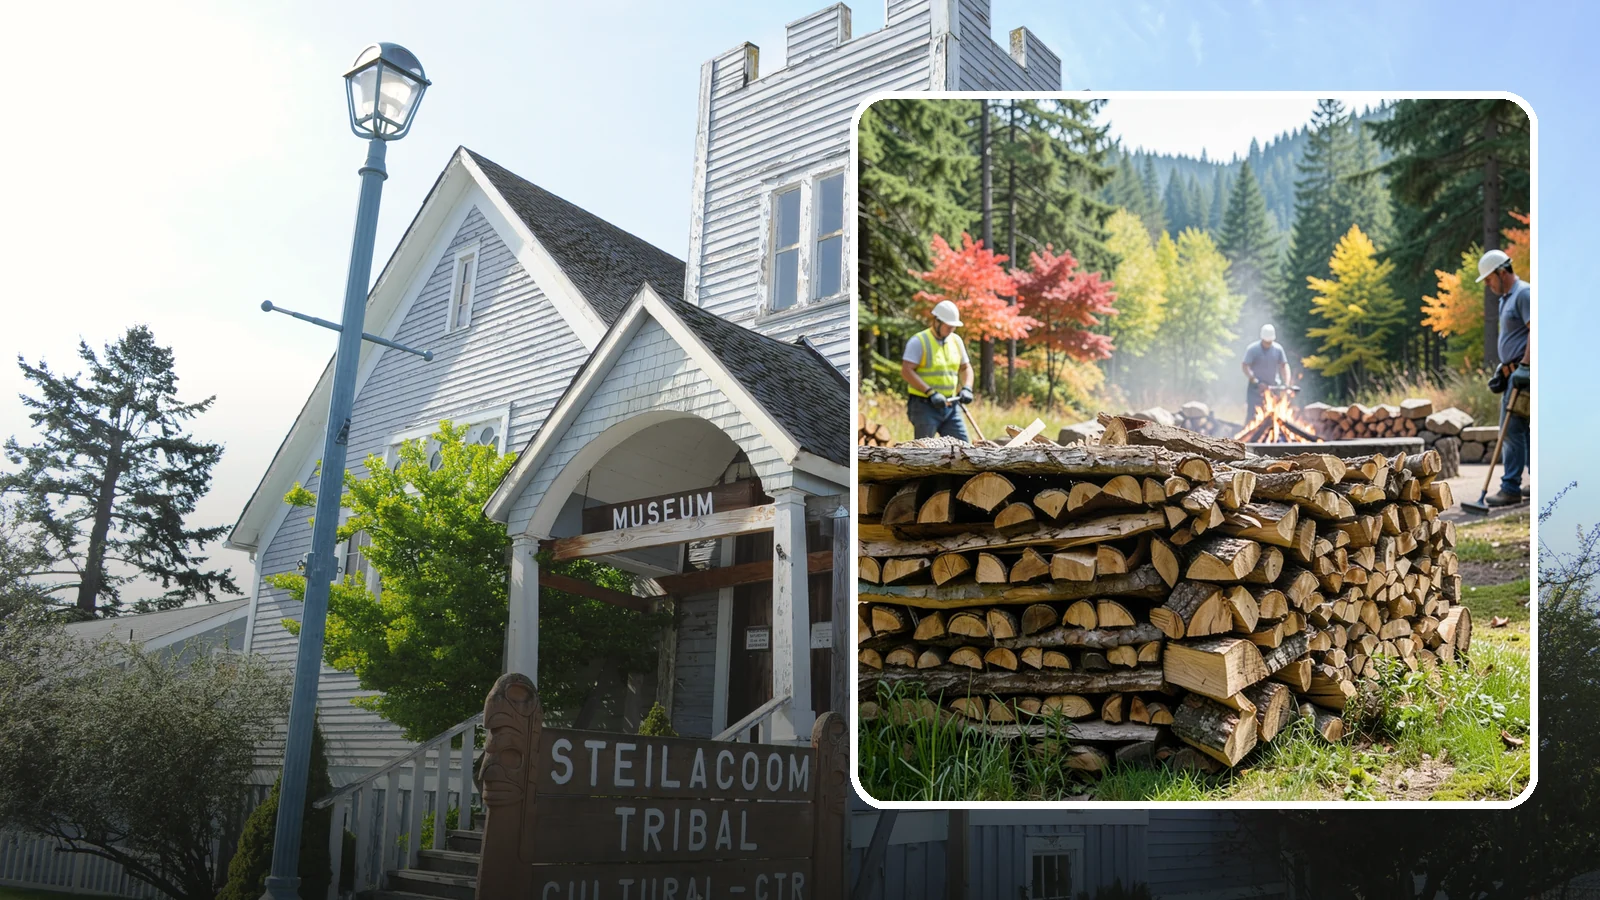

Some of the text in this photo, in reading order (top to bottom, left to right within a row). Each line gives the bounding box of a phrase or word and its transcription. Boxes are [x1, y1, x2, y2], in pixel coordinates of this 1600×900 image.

[613, 491, 713, 530] MUSEUM
[550, 738, 809, 793] STEILACOOM
[615, 806, 758, 852] TRIBAL
